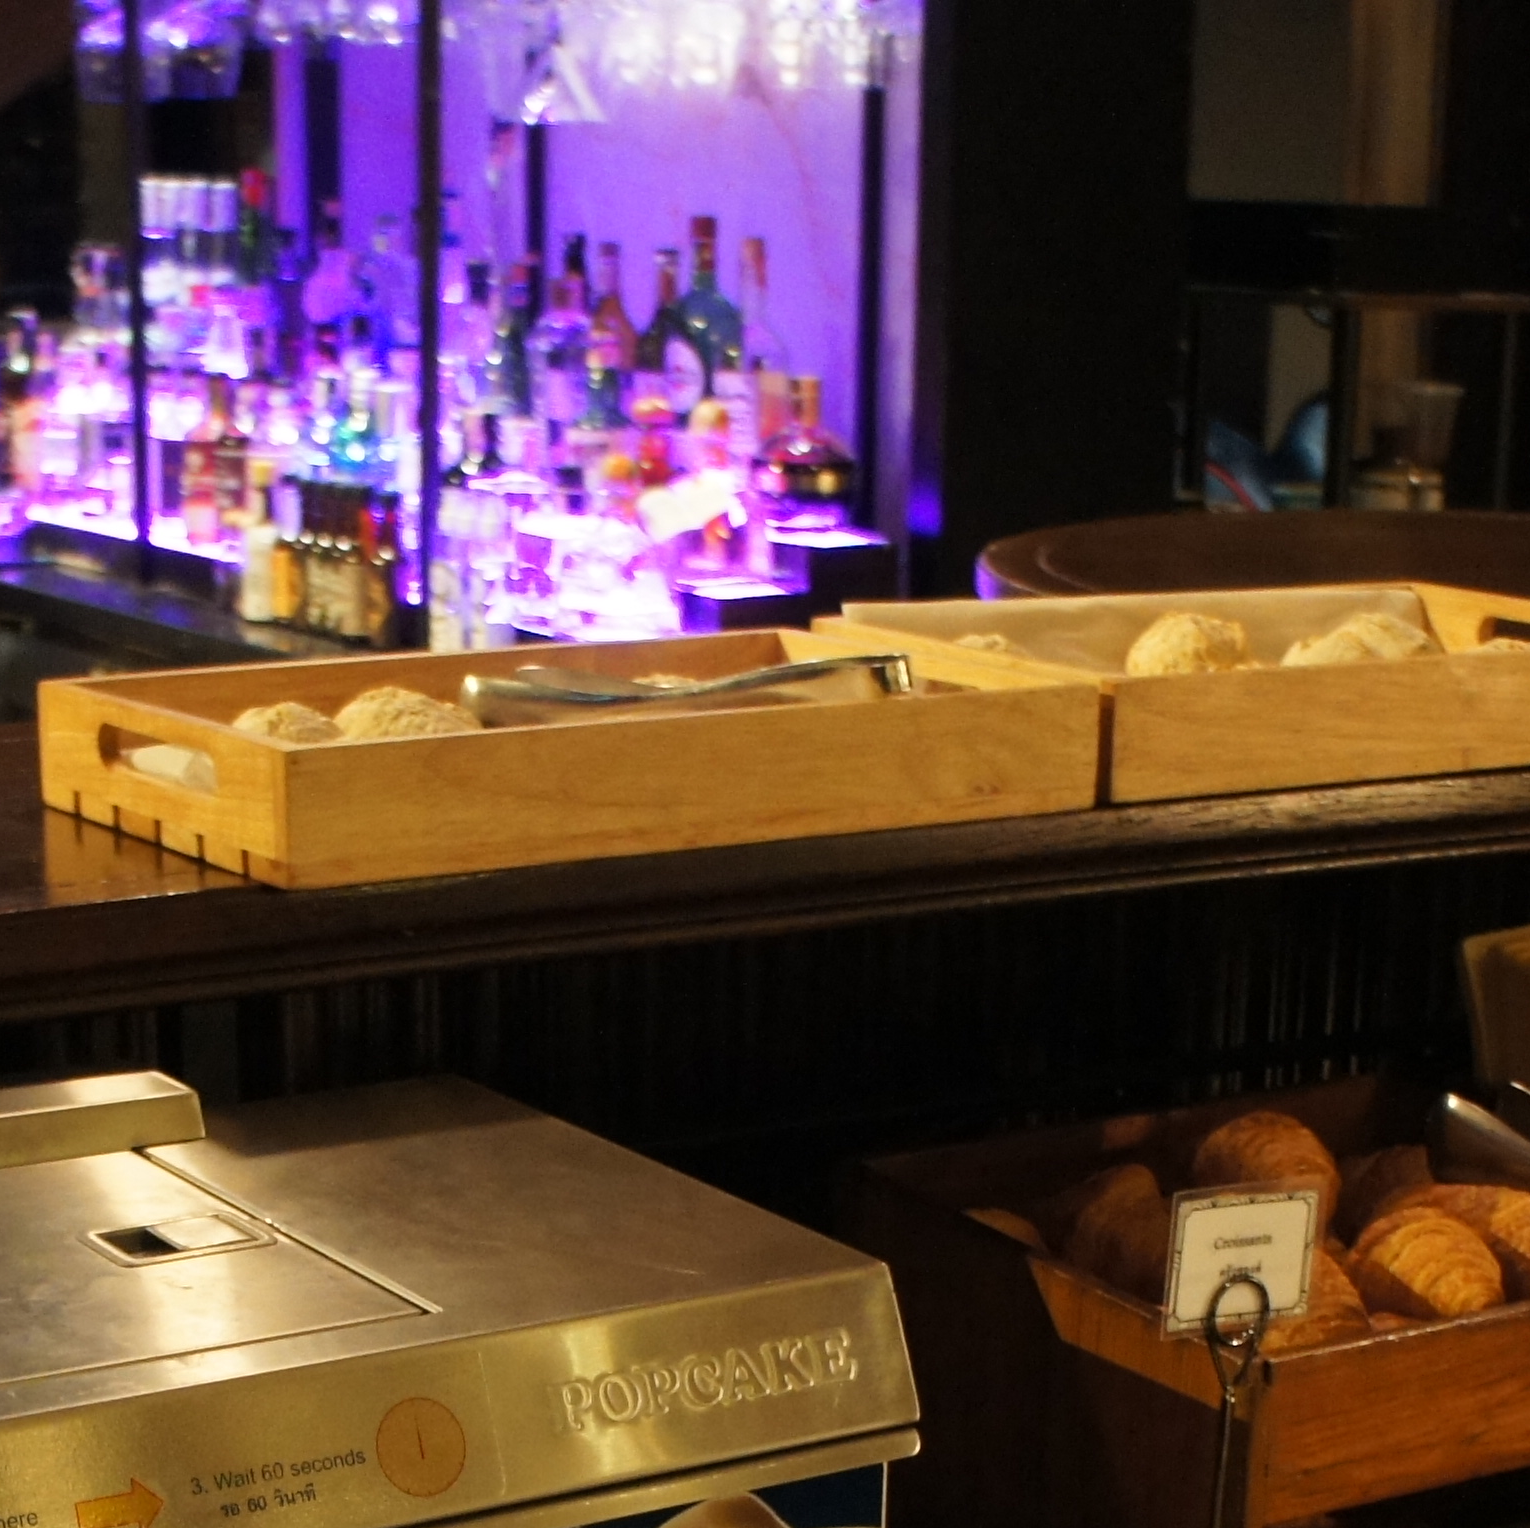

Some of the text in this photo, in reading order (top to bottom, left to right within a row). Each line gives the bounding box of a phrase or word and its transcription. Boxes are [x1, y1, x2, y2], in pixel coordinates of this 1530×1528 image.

[554, 1326, 859, 1432] POPCAKE
[190, 1449, 367, 1496] 3. Wait 60 seconds
[247, 1495, 268, 1513] 60
